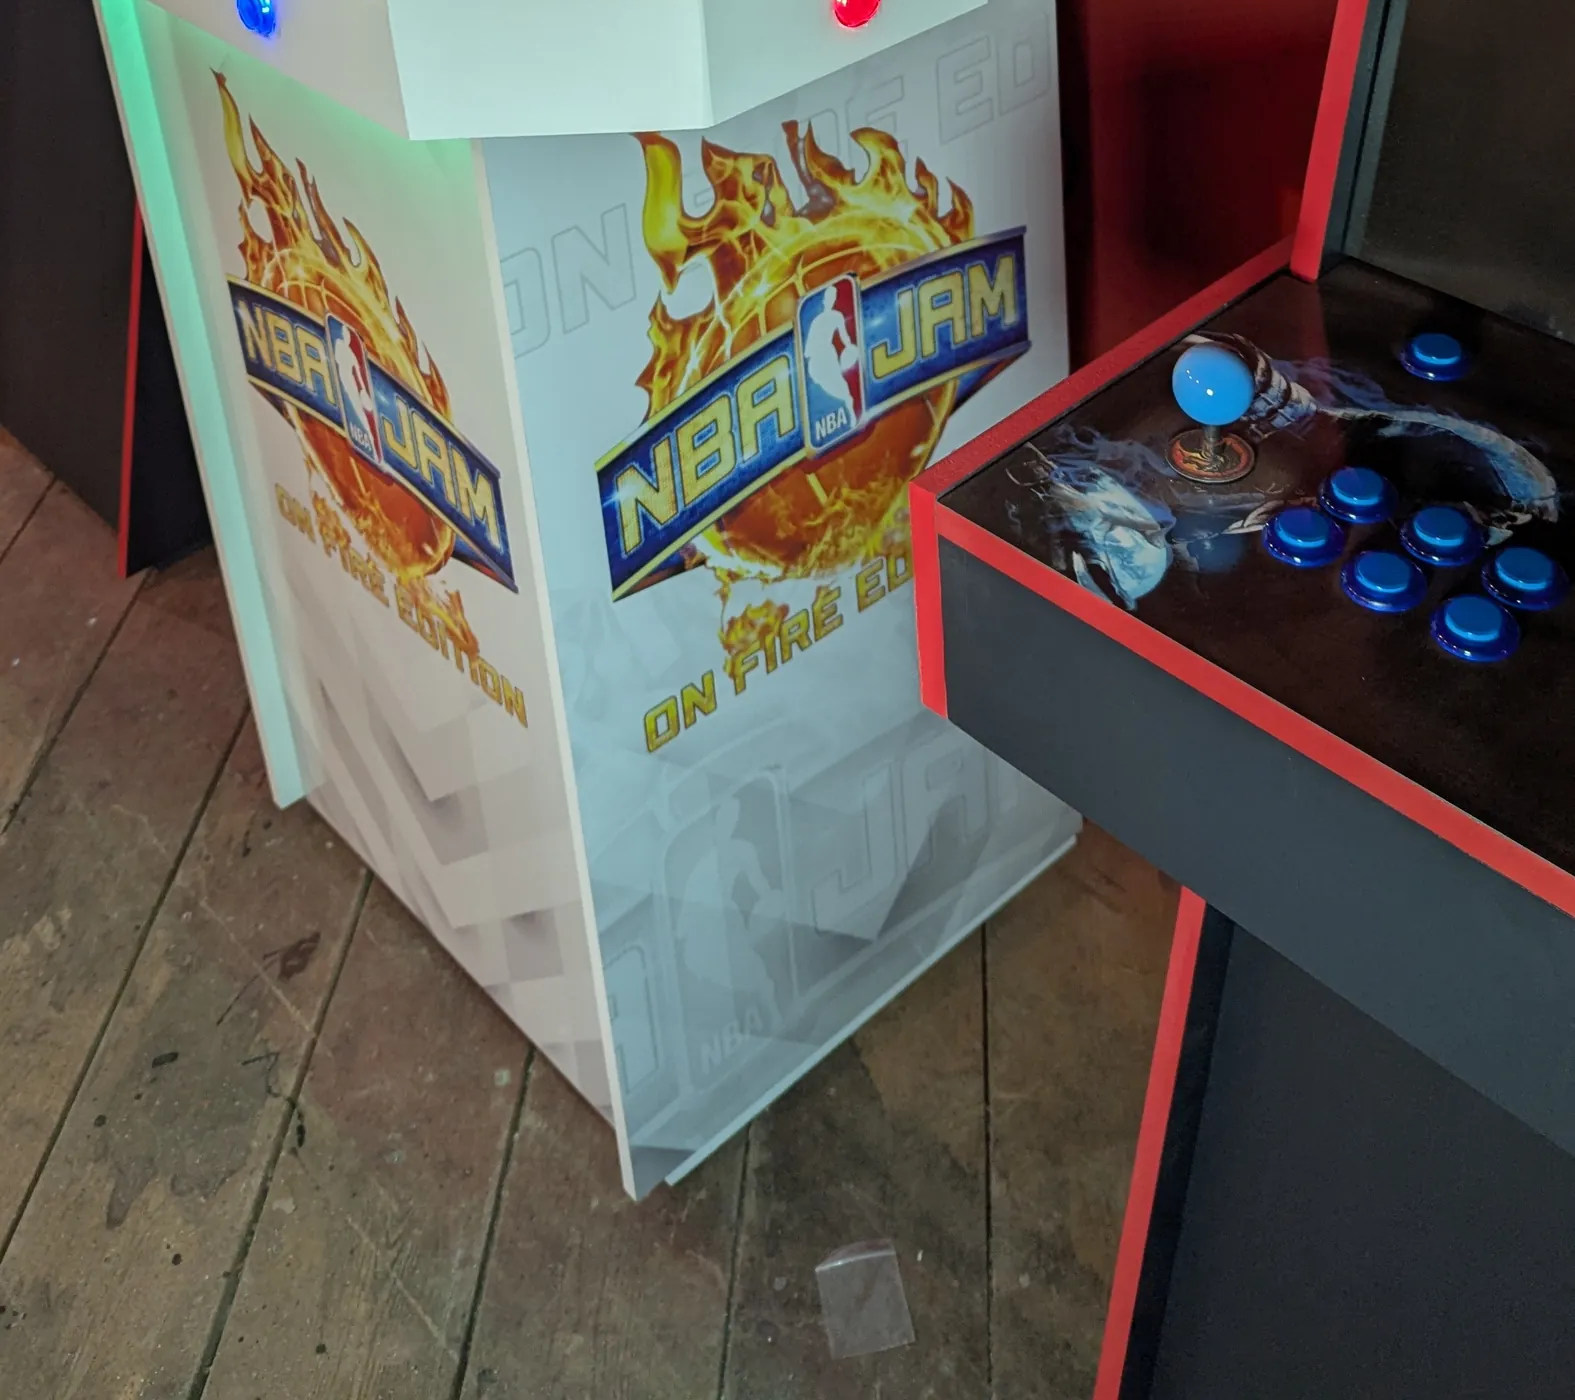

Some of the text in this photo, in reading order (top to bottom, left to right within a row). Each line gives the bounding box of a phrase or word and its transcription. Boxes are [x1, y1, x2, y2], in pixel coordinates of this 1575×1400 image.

[242, 297, 503, 550] NBA JAM
[349, 421, 371, 453] NBA
[613, 253, 1018, 556] NBA JAM
[814, 406, 849, 442] NBA
[394, 583, 529, 729] EDITION
[644, 668, 718, 754] ON
[734, 584, 845, 696] FIRE
